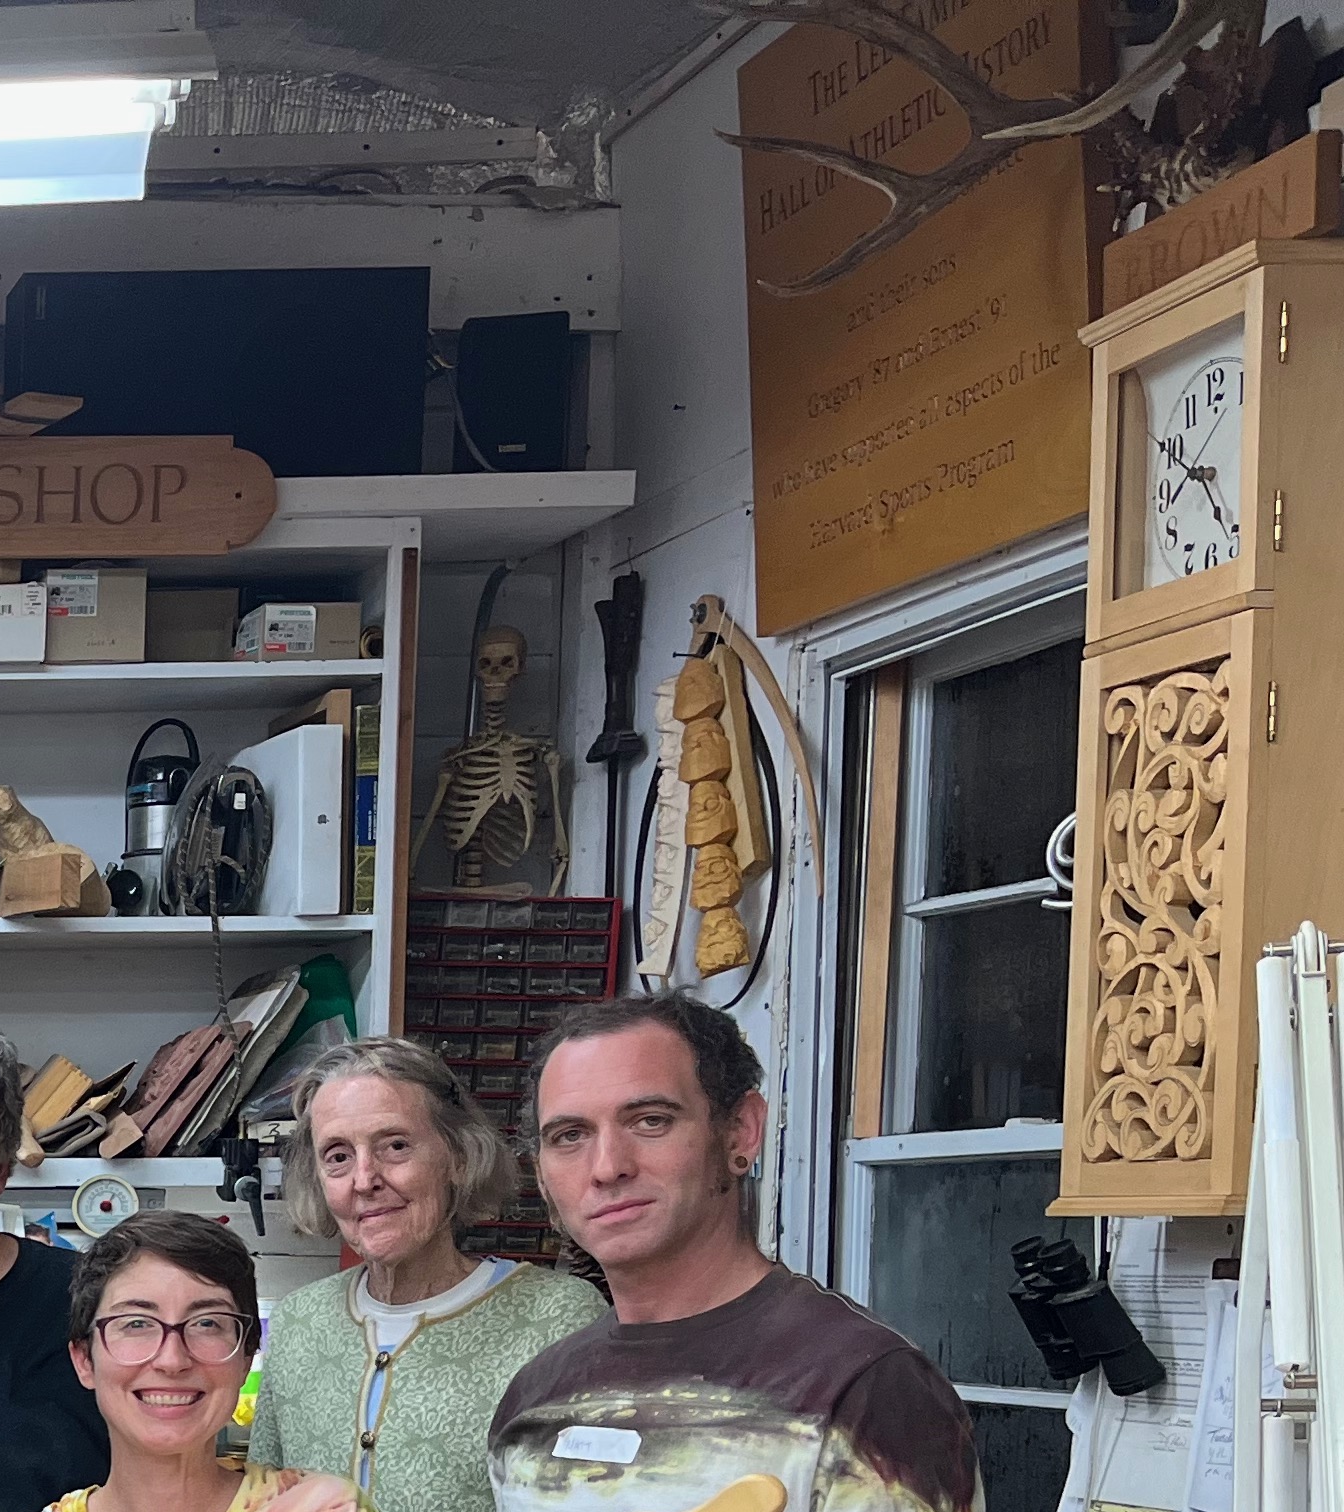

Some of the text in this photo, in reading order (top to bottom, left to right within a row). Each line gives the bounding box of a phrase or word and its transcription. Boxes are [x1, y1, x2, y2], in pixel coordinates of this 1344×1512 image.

[759, 176, 810, 234] HALL
[945, 372, 1004, 416] aspects
[1008, 350, 1026, 386] of
[1032, 341, 1062, 375] the
[1206, 367, 1224, 408] 12
[1183, 394, 1197, 430] 11
[1165, 433, 1184, 470] 10
[878, 475, 932, 519] Sports
[936, 439, 1016, 493] Program
[1159, 478, 1171, 514] 9
[1165, 515, 1178, 550] 8
